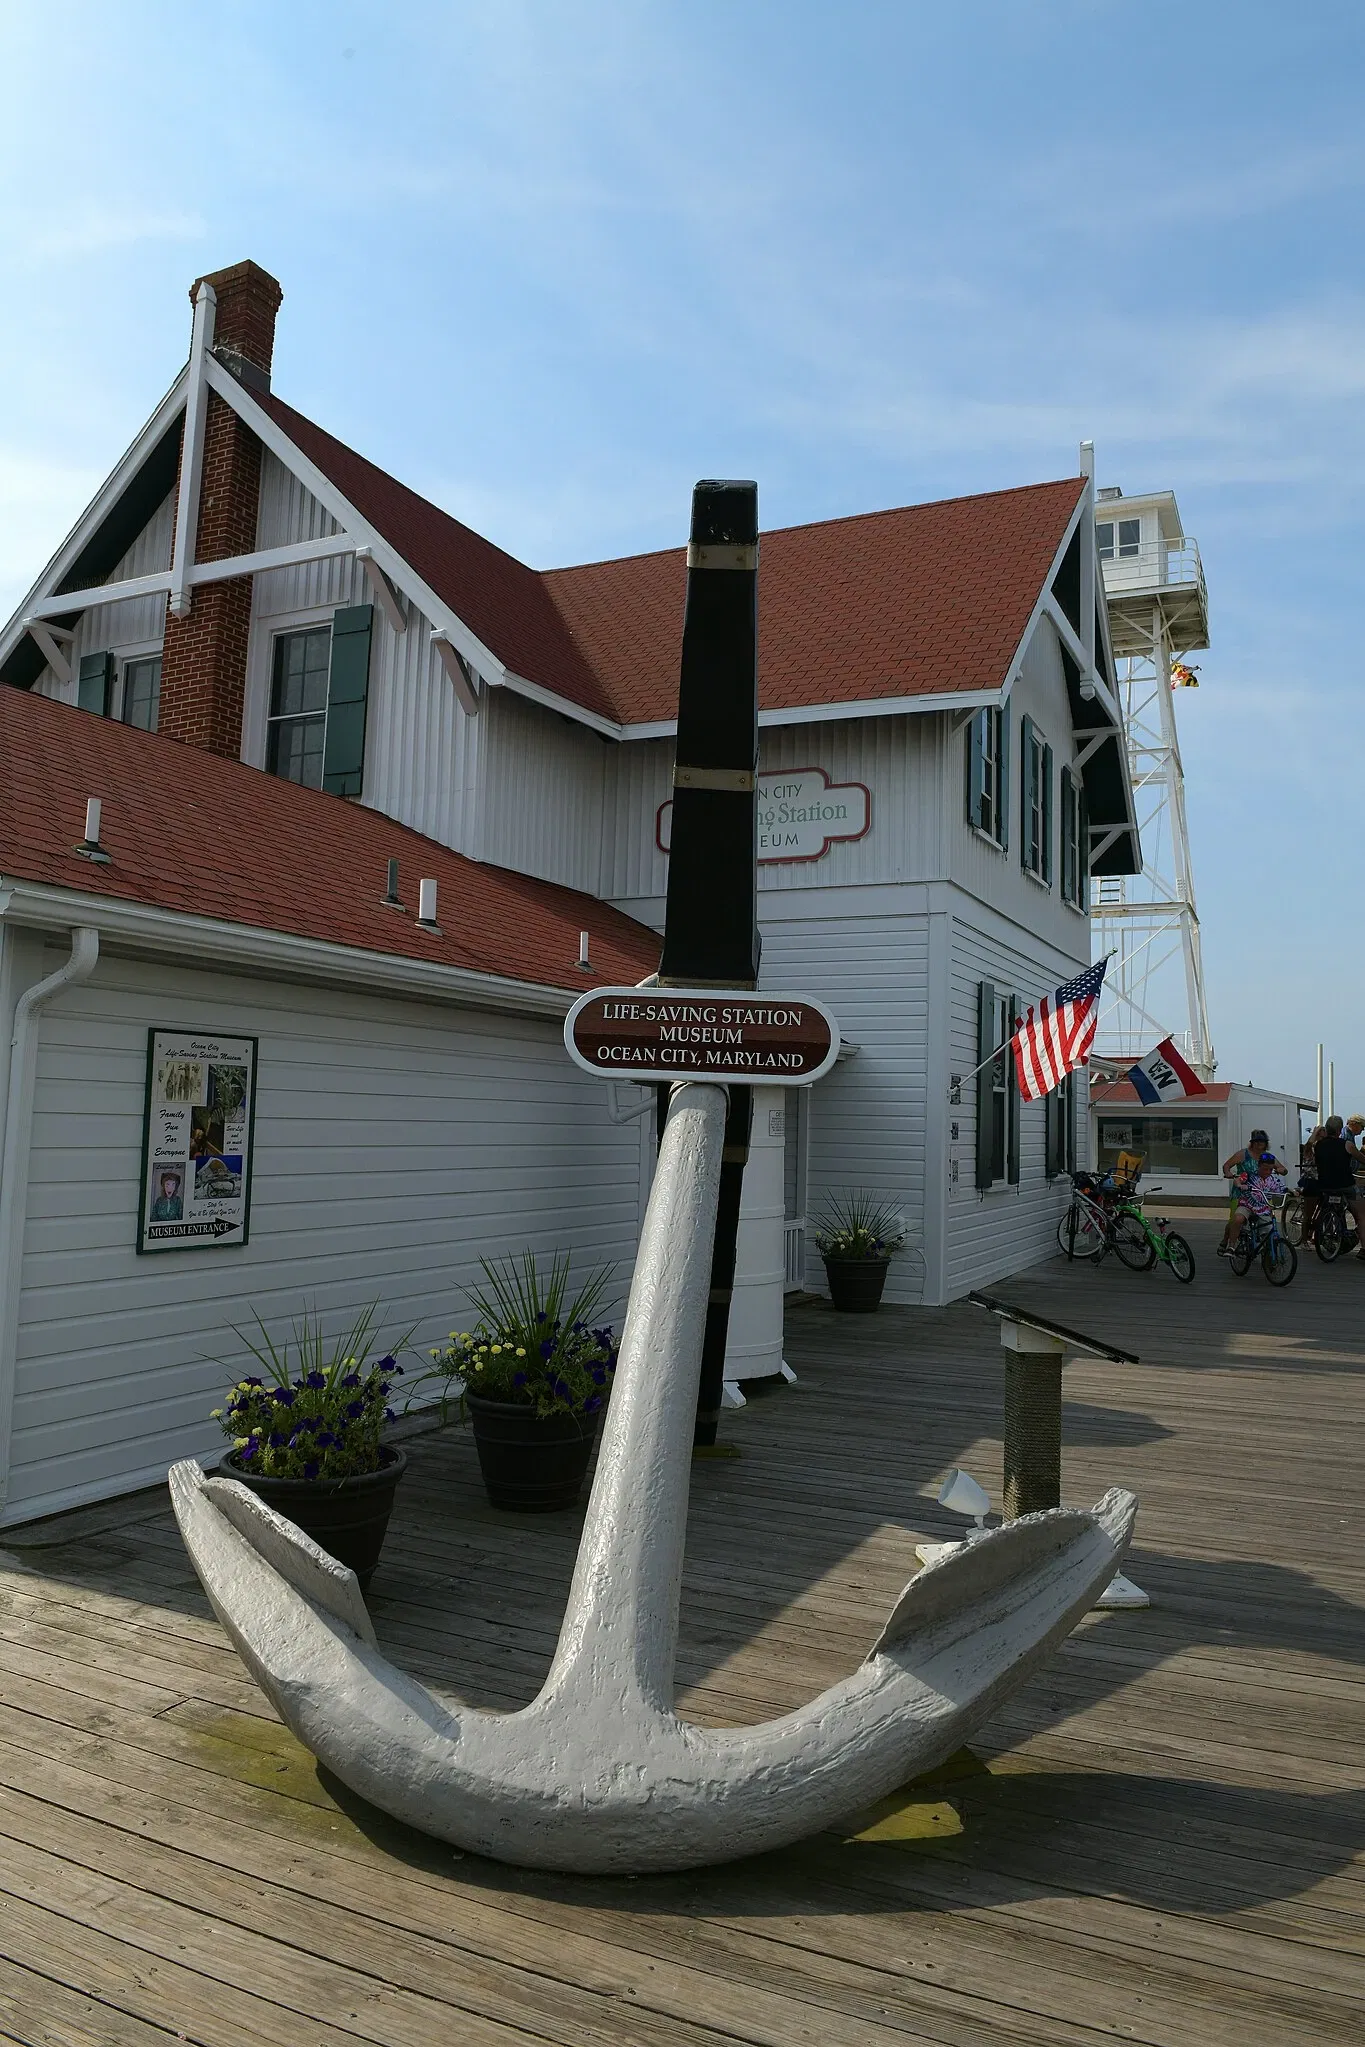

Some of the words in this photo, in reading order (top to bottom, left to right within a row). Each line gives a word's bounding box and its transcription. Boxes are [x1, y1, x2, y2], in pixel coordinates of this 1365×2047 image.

[773, 784, 802, 799] CITY
[777, 801, 848, 824] Station
[760, 833, 799, 848] EUM
[602, 1003, 717, 1023] LIFE-SAVING
[721, 1008, 803, 1026] STATION
[659, 1026, 743, 1044] MUSEUM
[191, 1042, 206, 1050] Ocean
[208, 1044, 220, 1052] City
[166, 1049, 198, 1060] Life-Saving
[220, 1053, 242, 1061] Museum
[597, 1046, 656, 1062] OCEAN
[660, 1048, 702, 1067] CITY,
[705, 1050, 804, 1068] MARYLAND
[160, 1110, 185, 1120] Family
[165, 1123, 179, 1132] Fun
[165, 1135, 177, 1144] For
[155, 1148, 186, 1157] Everyone
[151, 1227, 186, 1238] MUSEUM
[188, 1223, 229, 1235] ENTRANCE
